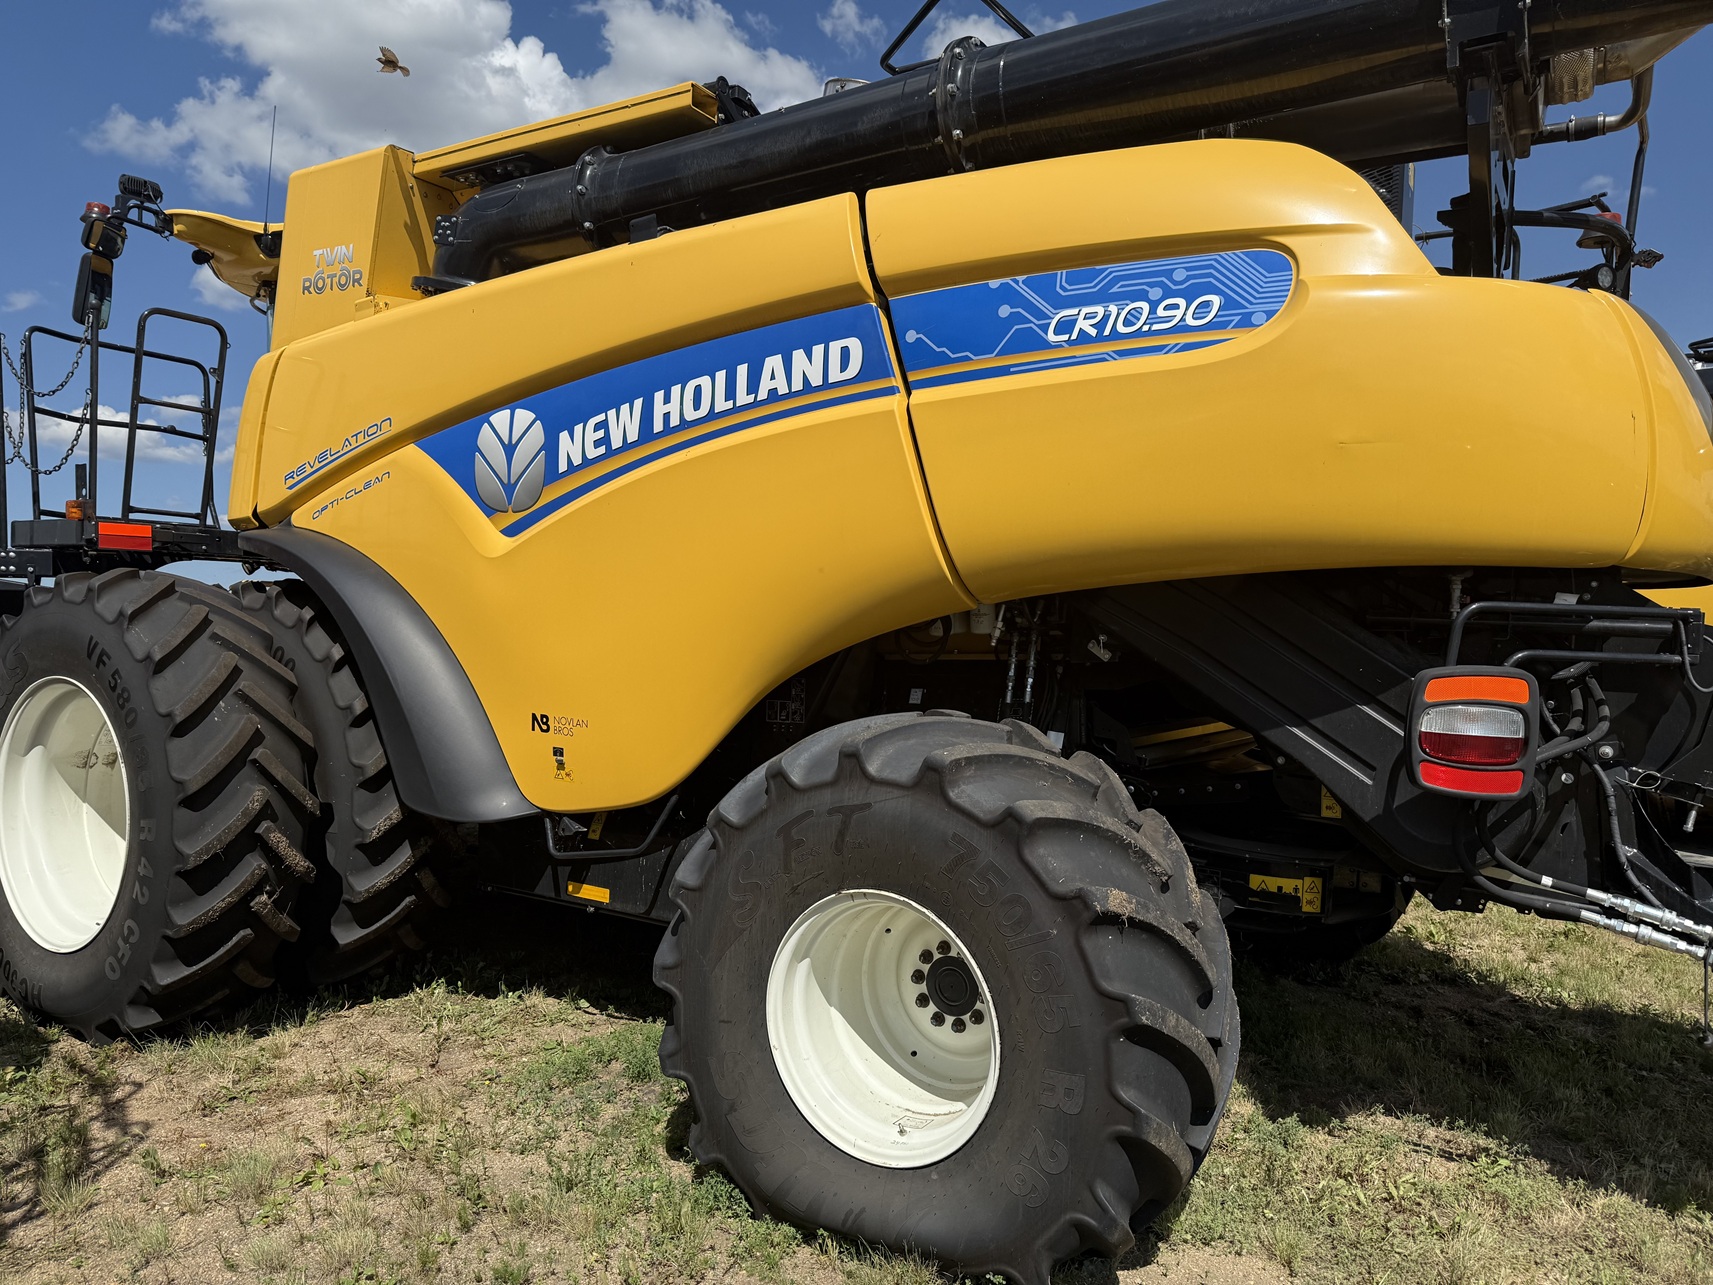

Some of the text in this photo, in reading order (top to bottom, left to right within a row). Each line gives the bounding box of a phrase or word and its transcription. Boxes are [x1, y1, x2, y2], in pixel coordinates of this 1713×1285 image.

[313, 244, 353, 268] TWIN
[302, 264, 363, 295] ROTOR
[1047, 294, 1221, 342] CR10.90
[558, 337, 863, 474] NEW HOLLAND
[284, 417, 392, 486] REVELATION
[312, 471, 390, 520] OPTI-CLEAN
[531, 712, 551, 734] NB
[553, 716, 589, 728] NOVLAN
[553, 726, 574, 737] BROS
[138, 816, 158, 843] R
[131, 855, 155, 906] 42
[940, 831, 1087, 1209] 750/65 R 26
